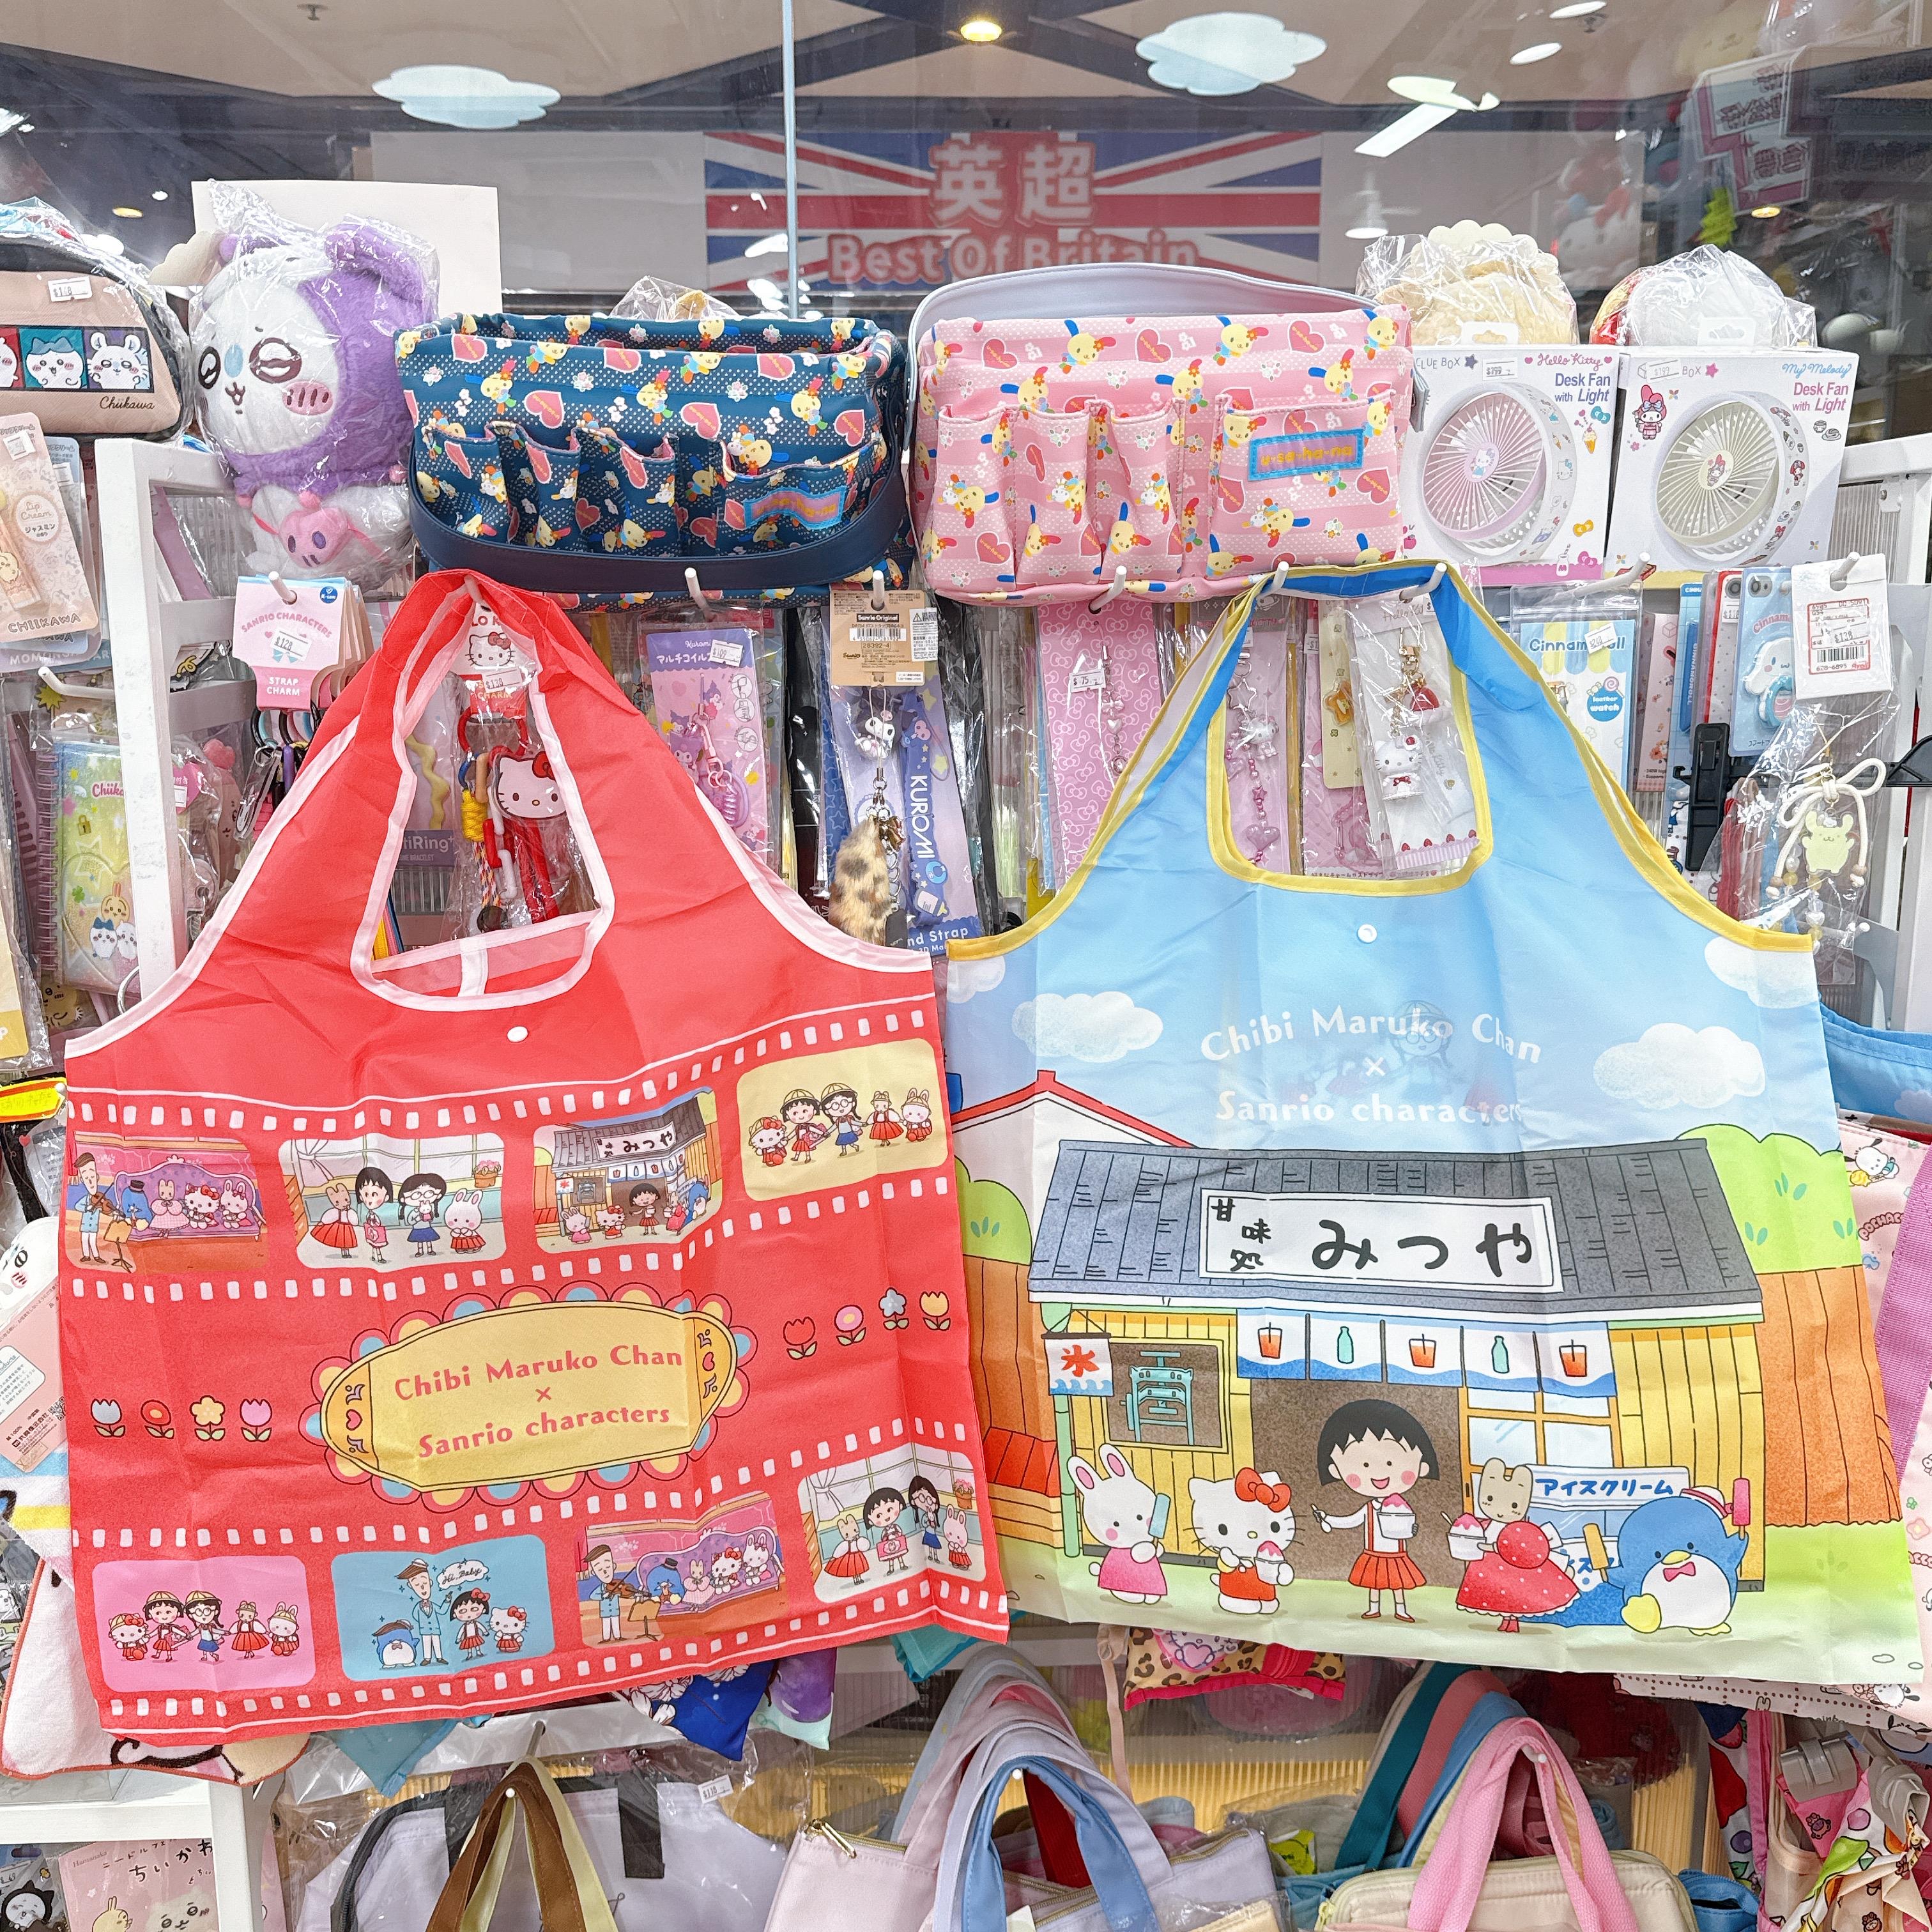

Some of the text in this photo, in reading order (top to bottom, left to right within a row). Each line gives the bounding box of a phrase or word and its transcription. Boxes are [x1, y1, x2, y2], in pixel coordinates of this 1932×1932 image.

[935, 142, 1094, 222] 英超
[829, 230, 1196, 280] Best Of Britain
[1416, 357, 1460, 369] CLUE BOX
[1537, 353, 1604, 371] Hello Kitty
[1782, 363, 1853, 378] My Melody
[1555, 373, 1611, 387] Desk Fan
[1682, 365, 1701, 378] BOX
[1554, 388, 1611, 406] with Light
[1794, 382, 1849, 395] Desk Fan
[100, 396, 155, 410] Chiikawa
[1792, 398, 1847, 414] with Light
[26, 502, 41, 511] Lip
[20, 511, 52, 521] Cream
[25, 523, 56, 533] ジャスミン
[8, 613, 82, 633] CHIIKAWA
[241, 611, 333, 638] SANRIO CHARACTERS
[1752, 613, 1791, 634] Cinnam
[274, 636, 293, 652] $128
[712, 647, 728, 659] $109
[269, 677, 299, 686] STRAP
[1687, 643, 1698, 706] CINNAMOROLL
[266, 686, 300, 696] CHARM
[477, 691, 513, 700] CHARM
[1590, 703, 1620, 712] watch
[910, 775, 936, 859] KUROMI
[930, 927, 969, 944] Strap
[1200, 1004, 1542, 1064] Chibi Maruko Chan
[1215, 1089, 1524, 1123] Sanrio characters
[622, 1131, 673, 1153] みつや
[1857, 1212, 1905, 1241] POCHAC
[1211, 1197, 1533, 1278] 甘味処 みつや
[1061, 1344, 1100, 1378] 氷
[395, 1344, 682, 1400] Chibi Maruko Chan
[418, 1406, 670, 1458] Sanrio characters
[1535, 1478, 1674, 1497] アイスクリーム
[73, 1851, 107, 1868] Hamanaka
[128, 1839, 213, 1883] ちいかわ
